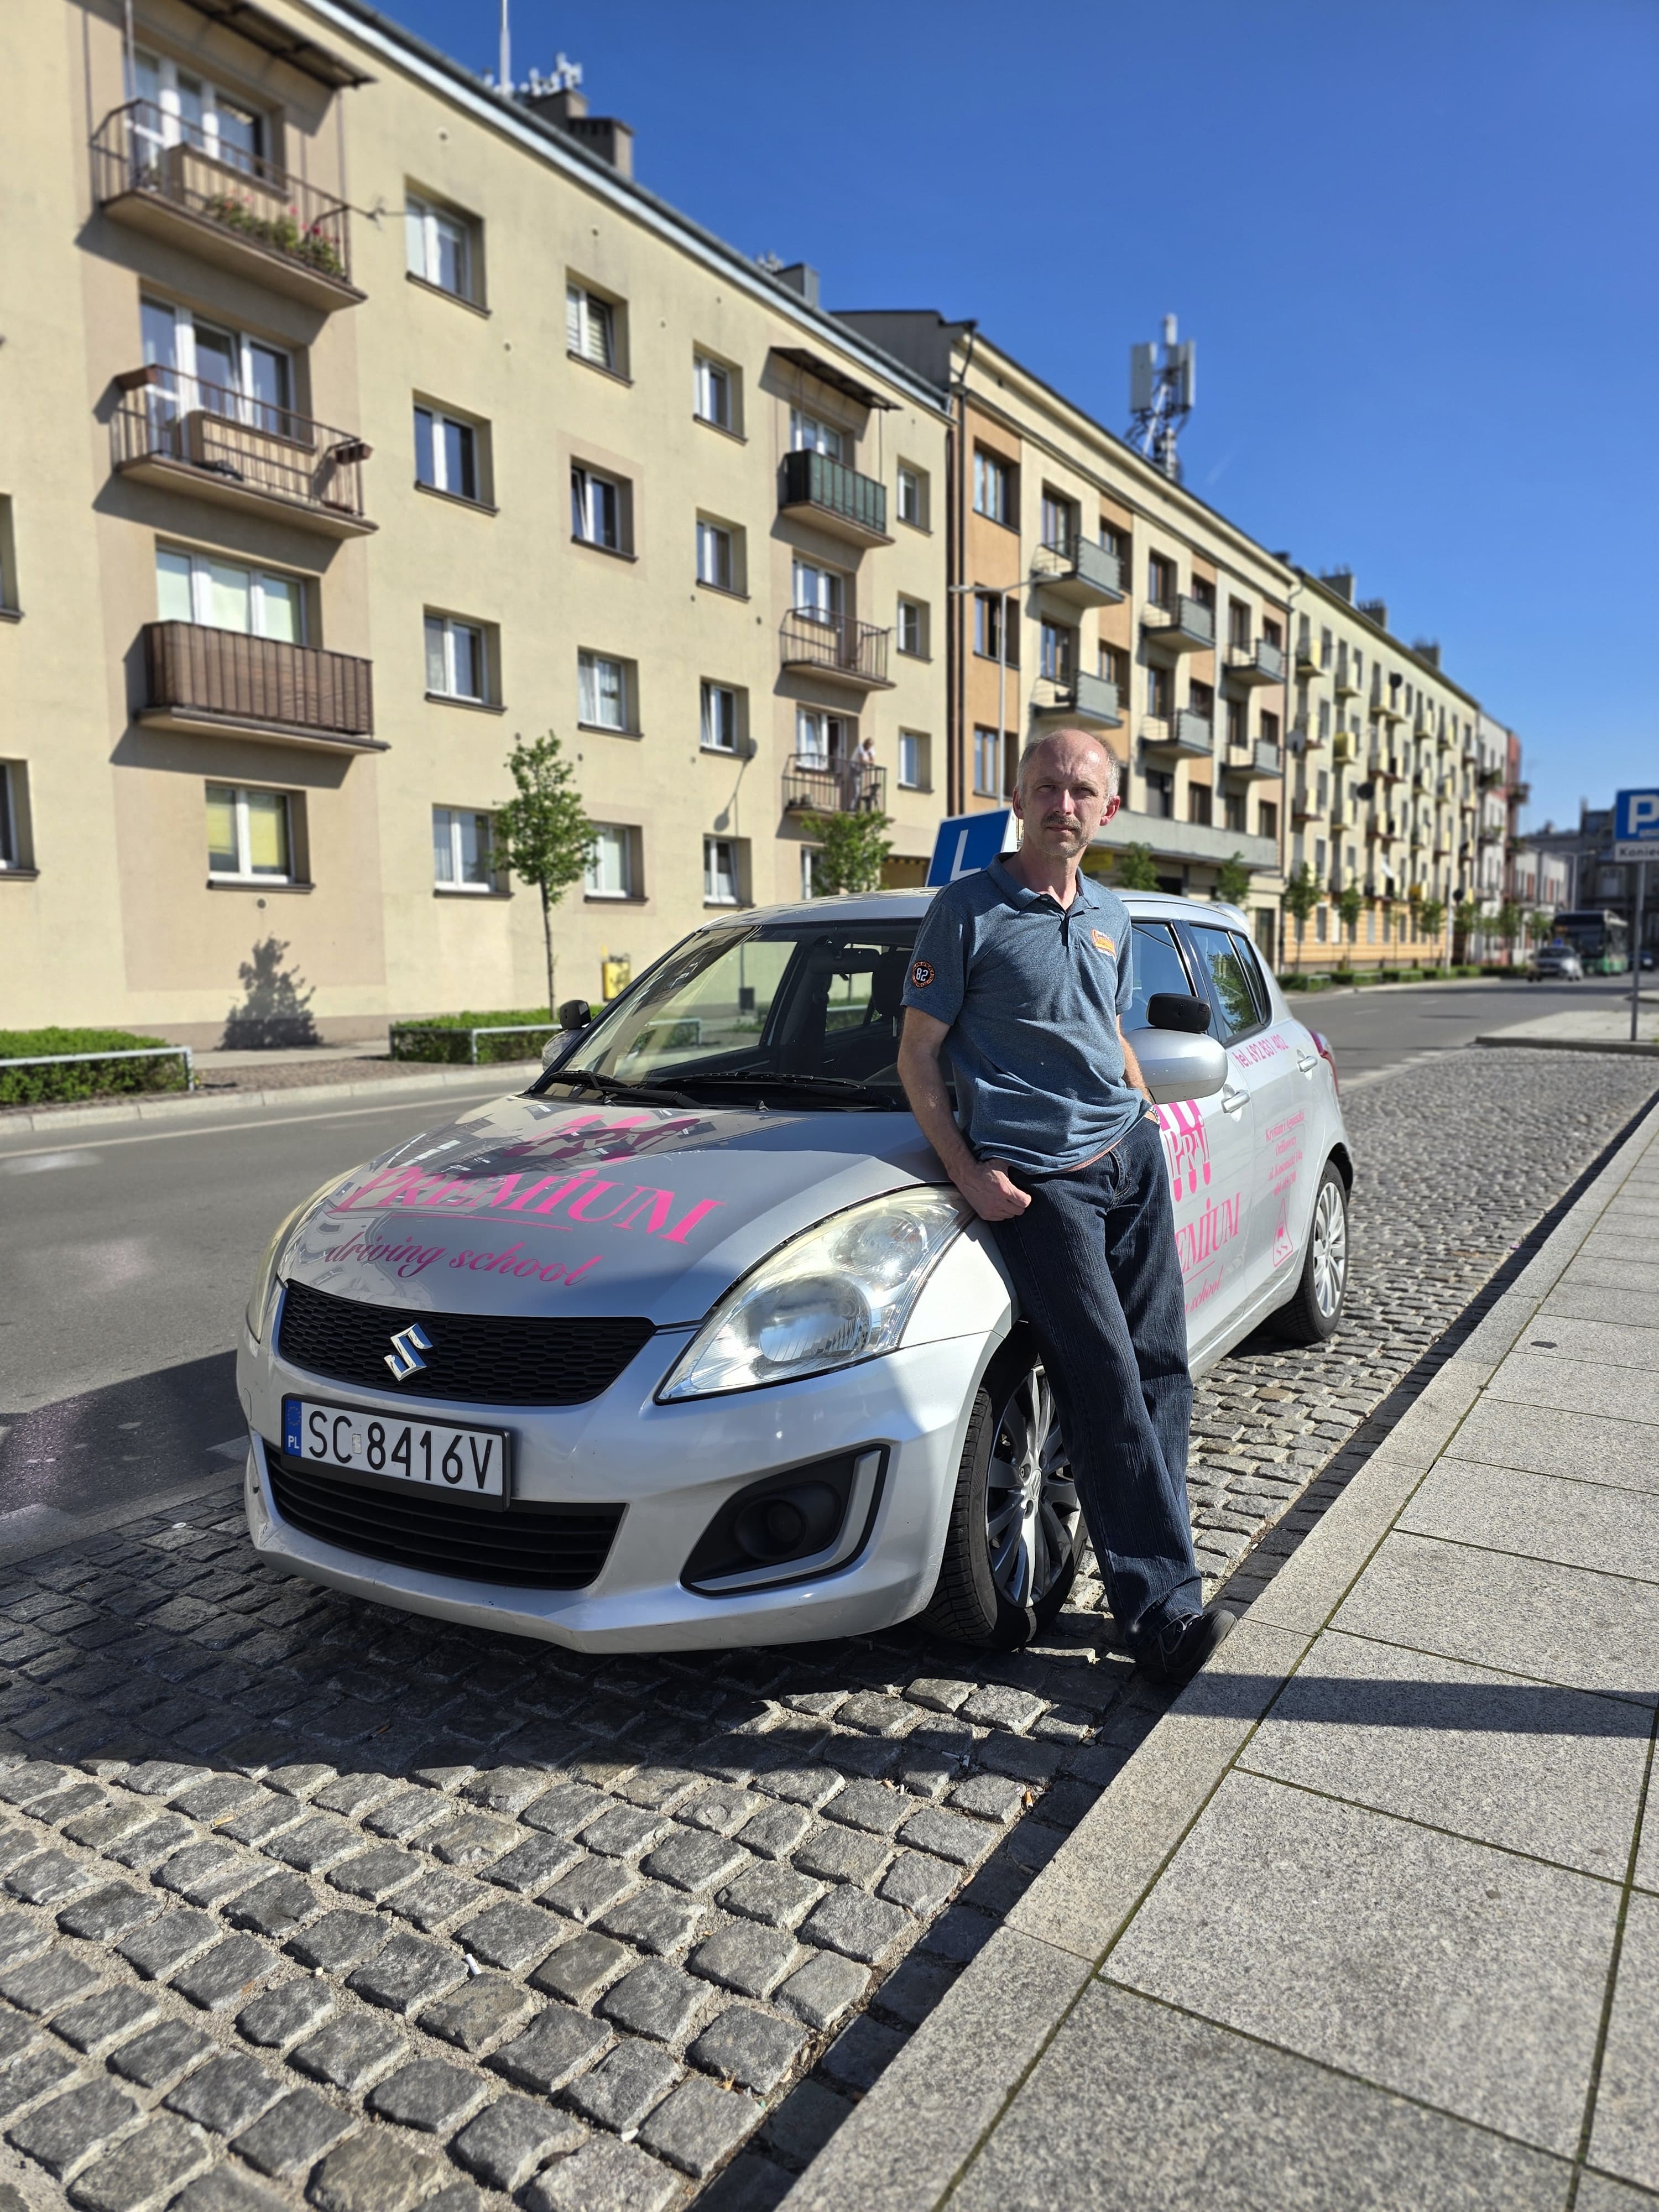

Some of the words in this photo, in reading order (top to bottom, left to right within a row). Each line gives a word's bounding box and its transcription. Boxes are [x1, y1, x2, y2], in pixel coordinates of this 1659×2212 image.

[1628, 795, 1659, 834] P
[950, 829, 982, 881] L
[1619, 847, 1659, 858] Konie
[916, 968, 928, 982] 82
[1232, 1049, 1254, 1068] tel.
[325, 1231, 448, 1278] driving
[449, 1242, 603, 1286] school
[1190, 1265, 1224, 1312] school
[288, 1434, 300, 1449] PL
[309, 1410, 353, 1464] SC
[367, 1421, 493, 1489] 8416V
